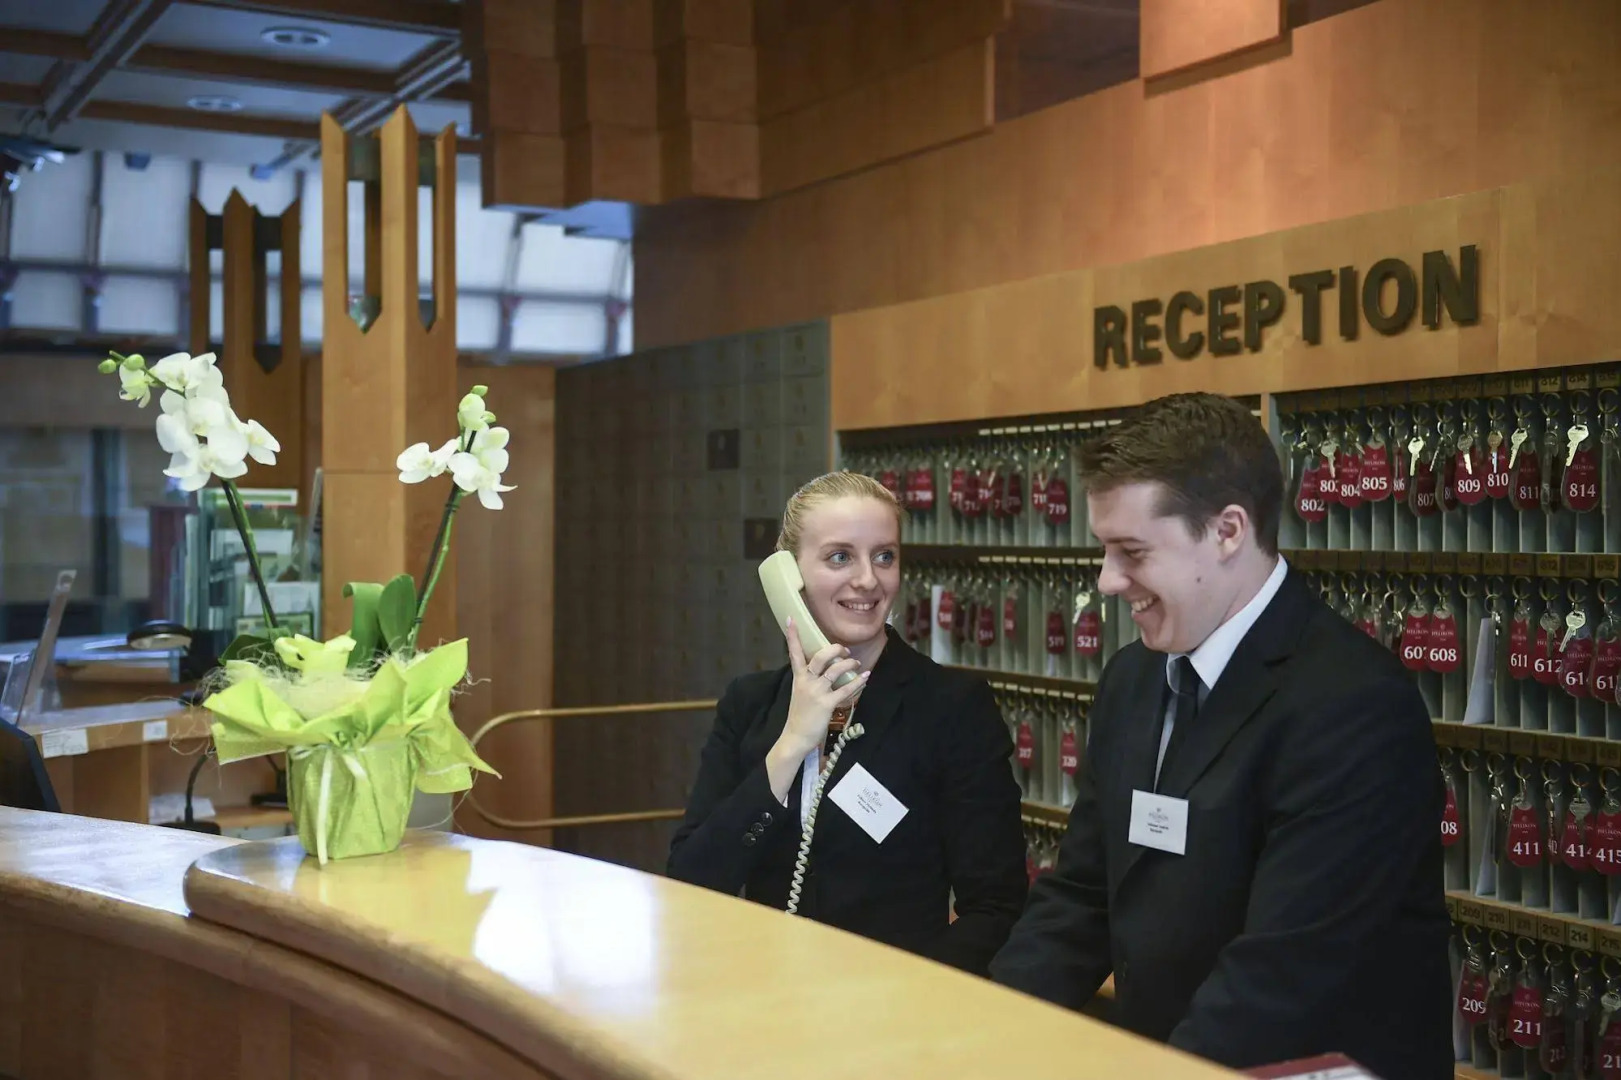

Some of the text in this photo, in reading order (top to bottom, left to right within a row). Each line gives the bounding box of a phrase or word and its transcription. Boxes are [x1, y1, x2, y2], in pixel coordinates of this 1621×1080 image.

[1093, 244, 1480, 370] RECEPTION
[1320, 479, 1339, 493] 80
[1362, 477, 1387, 490] 805
[1393, 478, 1405, 492] 806
[1457, 479, 1481, 493] 809
[1487, 472, 1509, 487] 810
[1519, 485, 1539, 500] 811
[1569, 482, 1596, 498] 814
[1301, 498, 1325, 512] 802
[1417, 492, 1434, 507] 807
[1077, 636, 1098, 648] 521
[1429, 648, 1457, 662] 608
[1510, 652, 1528, 668] 611
[1534, 658, 1563, 673] 612
[1565, 671, 1589, 686] 61
[1596, 674, 1619, 690] 61
[1512, 841, 1540, 856] 411
[1595, 848, 1621, 864] 415
[1570, 929, 1589, 943] 214
[1462, 997, 1487, 1014] 209
[1513, 1019, 1542, 1036] 211
